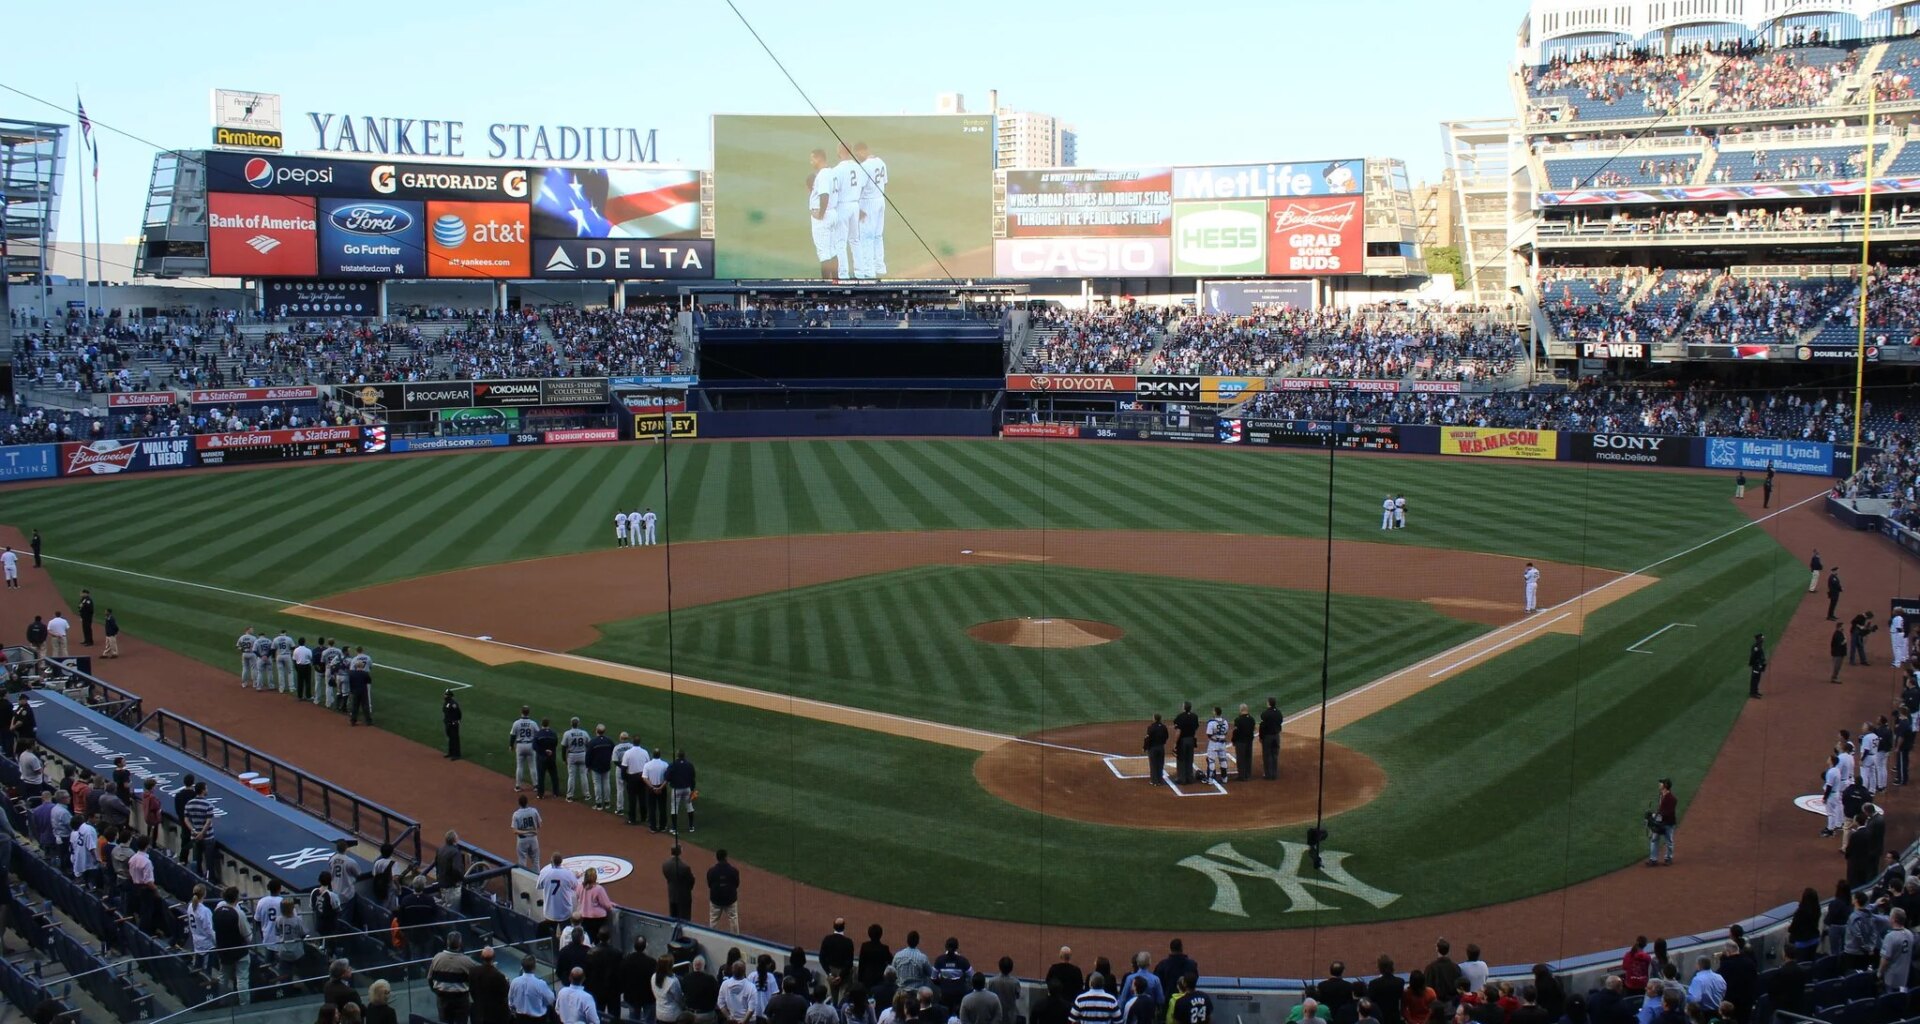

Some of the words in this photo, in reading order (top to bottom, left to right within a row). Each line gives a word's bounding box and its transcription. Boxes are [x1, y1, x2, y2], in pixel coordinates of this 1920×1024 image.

[218, 129, 281, 147] Armitron
[306, 112, 464, 158] YANKEE
[488, 123, 660, 164] STADIUM
[277, 166, 332, 187] pepsi
[402, 172, 497, 190] GATORADE
[850, 170, 857, 187] 2
[1182, 164, 1312, 198] MetLife
[1009, 194, 1038, 208] WHOSE
[1039, 193, 1063, 207] BROAD
[1064, 193, 1097, 207] STRIPES
[1098, 192, 1114, 206] AND
[1114, 192, 1144, 206] BRIGHT
[209, 213, 244, 228] Bank
[246, 215, 260, 228] of
[261, 216, 316, 230] America
[346, 208, 396, 230] Ford
[1016, 213, 1061, 226] THROUGH
[1064, 212, 1082, 225] THE
[1083, 212, 1128, 225] PERILOUS
[1274, 208, 1354, 229] Budweiser
[473, 220, 525, 243] at&t
[1183, 227, 1257, 248] HESS
[1289, 234, 1342, 248] GRAB
[344, 244, 360, 254] Go
[362, 245, 400, 255] Further
[1298, 248, 1332, 256] SOME
[449, 258, 510, 267] att.yankees.com
[586, 248, 703, 269] DELTA
[1012, 242, 1154, 272] CASIO
[1290, 256, 1341, 270] BUDS
[489, 385, 537, 394] YOKOHAMA
[1053, 378, 1114, 390] TOYOTA
[1138, 382, 1199, 396] DKNY
[1219, 384, 1242, 396] SAP
[1353, 382, 1394, 390] MODELL'S
[1414, 383, 1459, 391] MODELL'S
[416, 391, 469, 401] ROCAWEAR
[623, 397, 650, 406] Peanut
[1120, 401, 1144, 410] FedEx
[640, 420, 690, 431] STANLEY
[1593, 435, 1664, 450] SONY
[1596, 451, 1657, 462] make.believe
[1742, 442, 1782, 456] Merrill
[1786, 445, 1820, 459] Lynch
[69, 452, 136, 465] Budweiser
[149, 457, 156, 466] A
[158, 452, 183, 465] HERO
[1774, 460, 1827, 473] Management
[520, 728, 531, 738] 28
[571, 738, 584, 747] 48
[335, 865, 342, 878] 2
[550, 879, 561, 896] 7
[267, 908, 277, 922] 2
[1901, 940, 1908, 953] 2
[1190, 1006, 1206, 1023] 24
